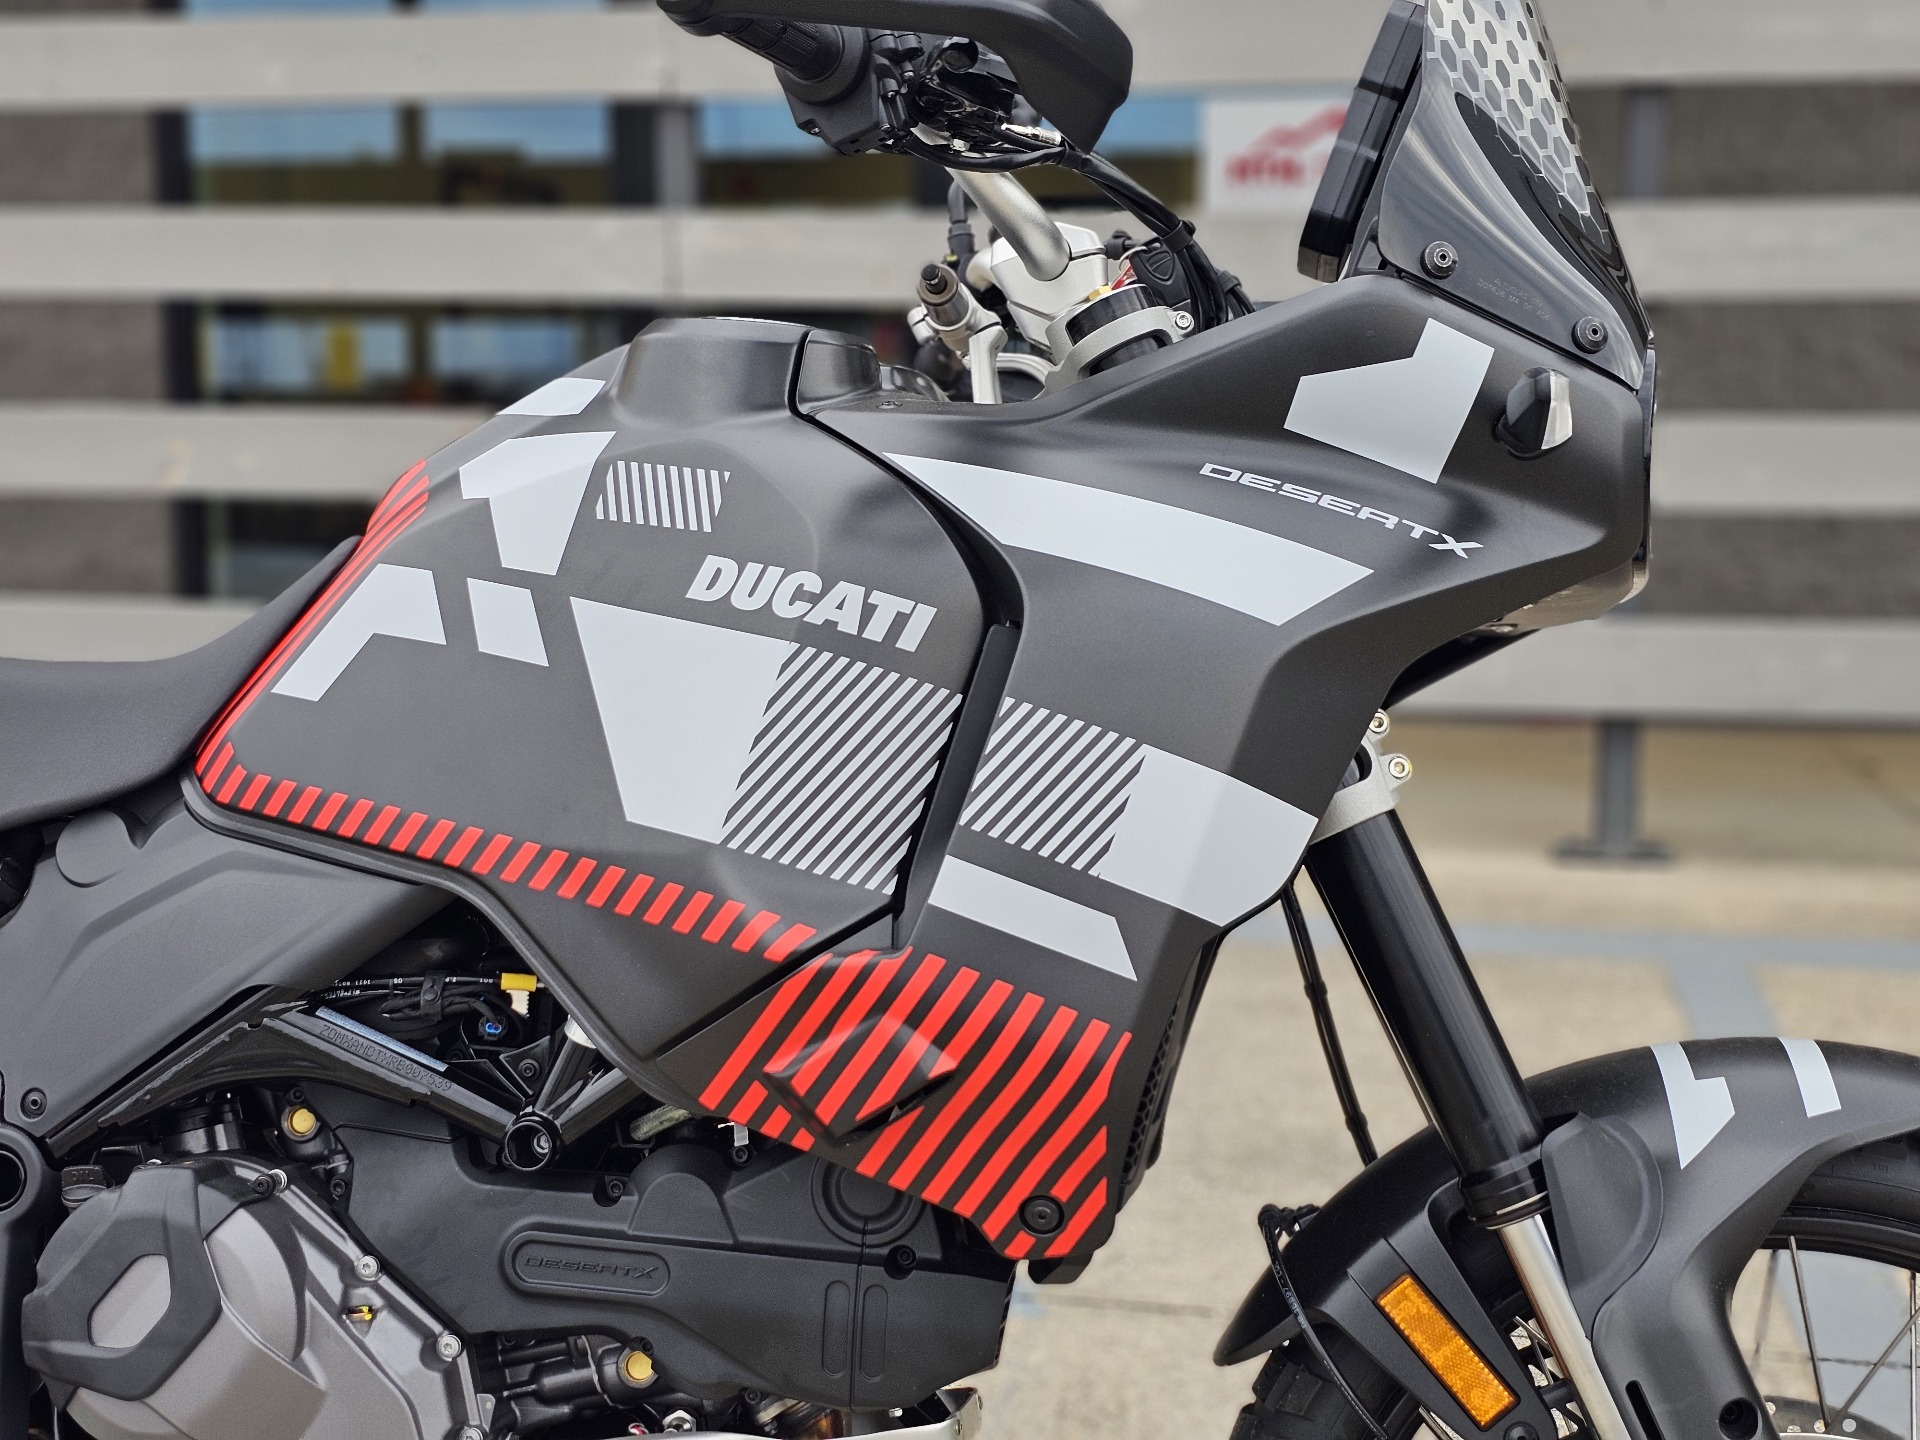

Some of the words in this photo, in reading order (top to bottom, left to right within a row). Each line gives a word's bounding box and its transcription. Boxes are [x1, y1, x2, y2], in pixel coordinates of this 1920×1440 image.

[1199, 462, 1485, 559] DESERTX
[685, 554, 938, 653] DUCATI
[524, 1256, 659, 1279] DESERTX
